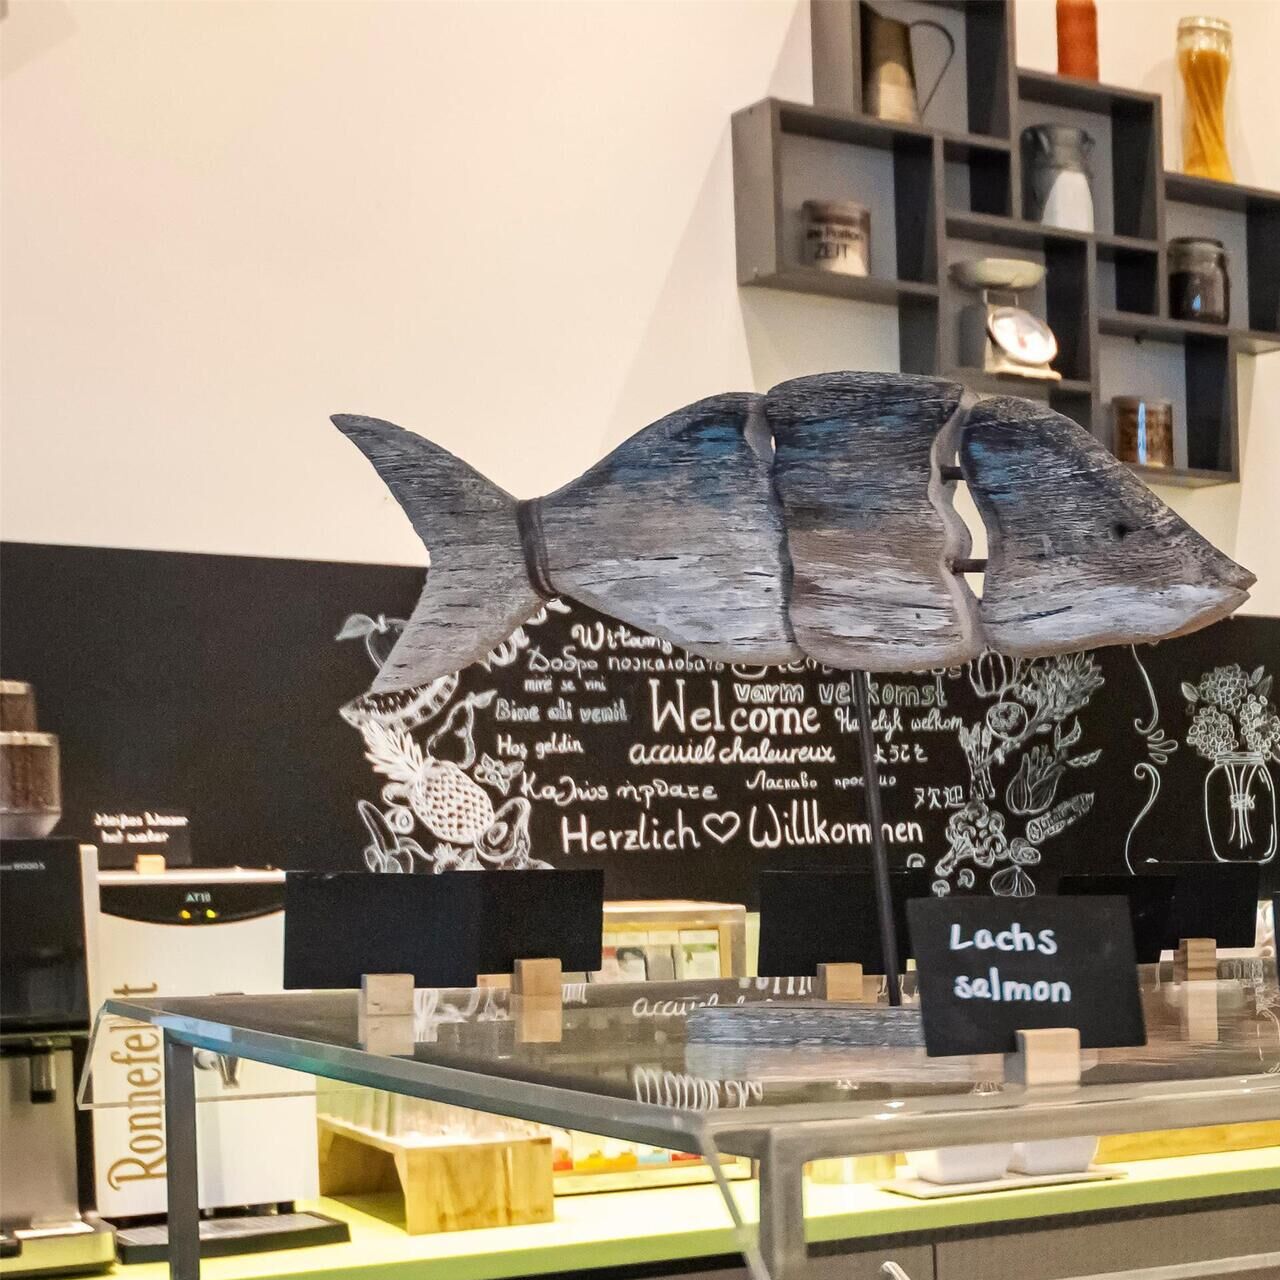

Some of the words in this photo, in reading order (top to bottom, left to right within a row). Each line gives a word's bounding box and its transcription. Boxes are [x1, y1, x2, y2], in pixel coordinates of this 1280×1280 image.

[528, 646, 598, 678] Добро
[560, 678, 576, 692] se
[585, 676, 607, 692] vini
[734, 682, 804, 703] varm
[495, 698, 540, 721] Bine
[649, 679, 821, 735] Welcome
[834, 706, 903, 742] Haelijk
[911, 707, 963, 731] welkom
[535, 731, 584, 760] geldin
[719, 735, 836, 764] chaleureux
[746, 770, 818, 791] Ласкаво
[561, 807, 700, 854] Herzlich
[750, 799, 923, 848] Willkommen
[950, 923, 1058, 955] Lachs
[954, 967, 1071, 1003] salmon
[108, 983, 167, 1191] Ronnefelt
